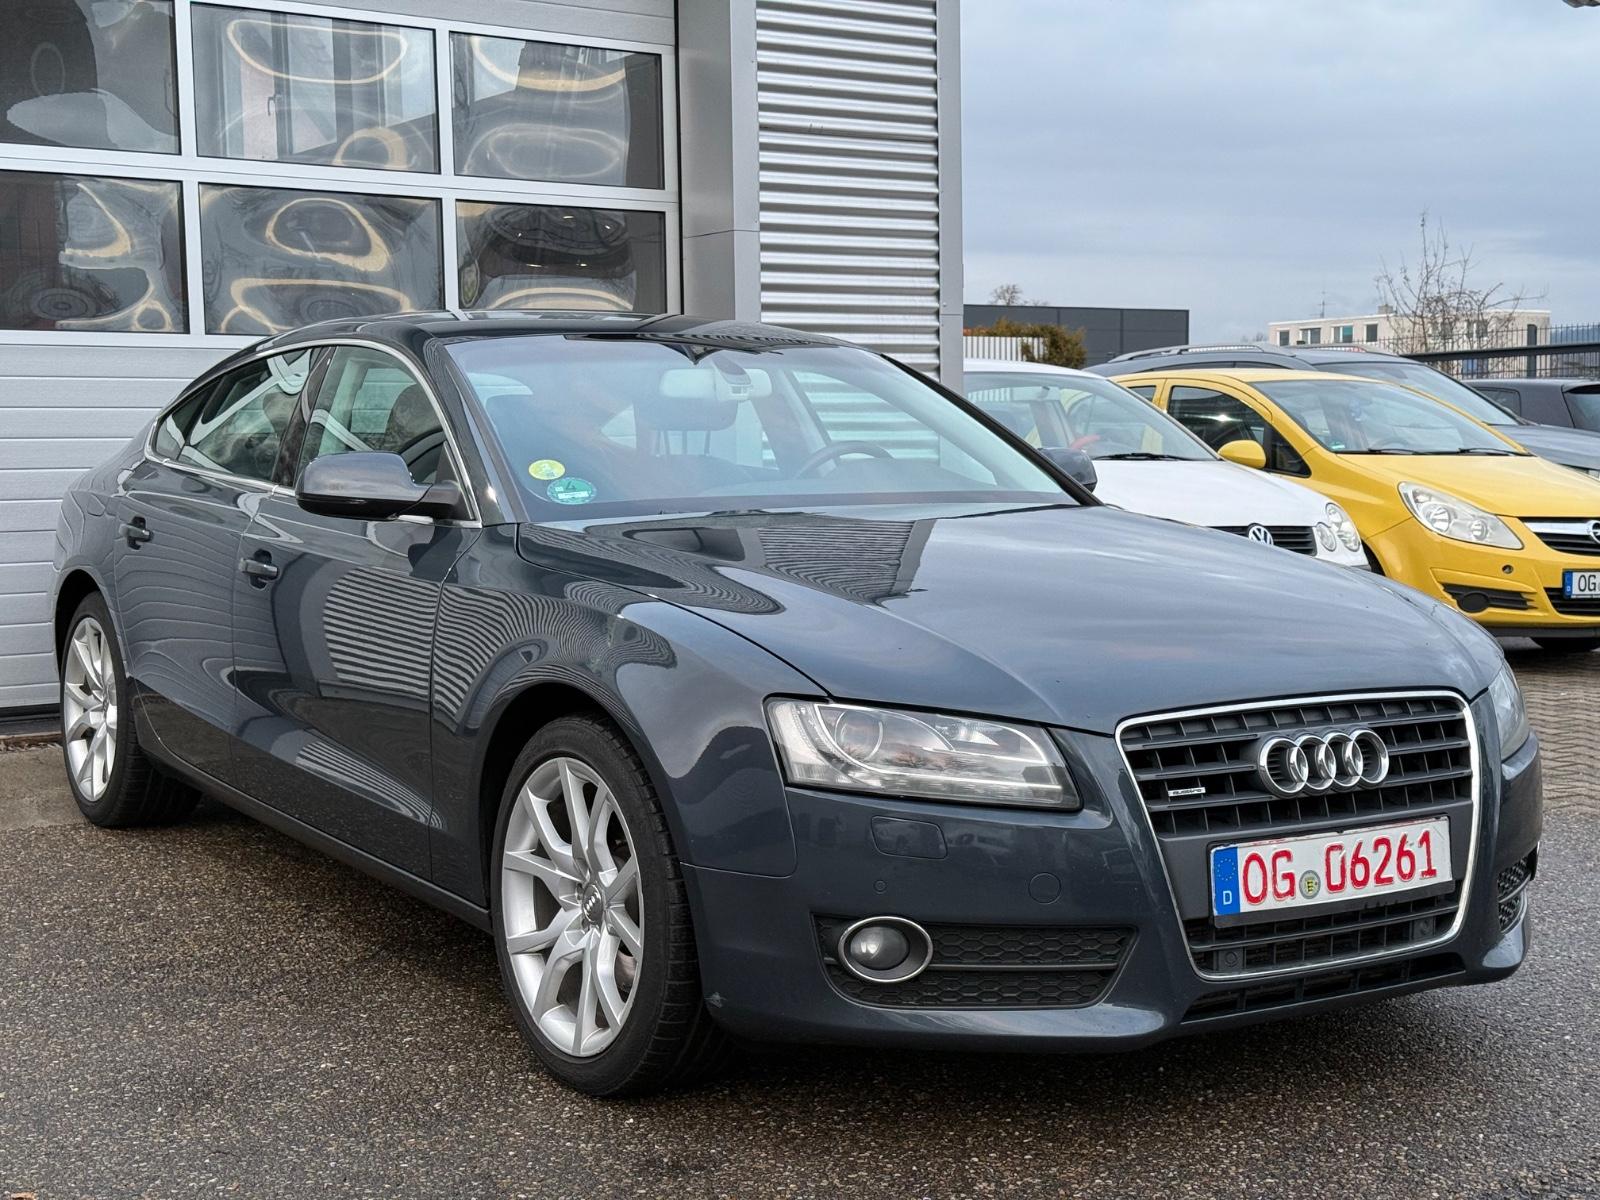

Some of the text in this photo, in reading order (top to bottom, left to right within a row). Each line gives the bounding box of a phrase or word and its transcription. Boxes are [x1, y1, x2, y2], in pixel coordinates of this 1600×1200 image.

[1578, 574, 1597, 592] OG
[1222, 830, 1437, 906] D OG 06261
